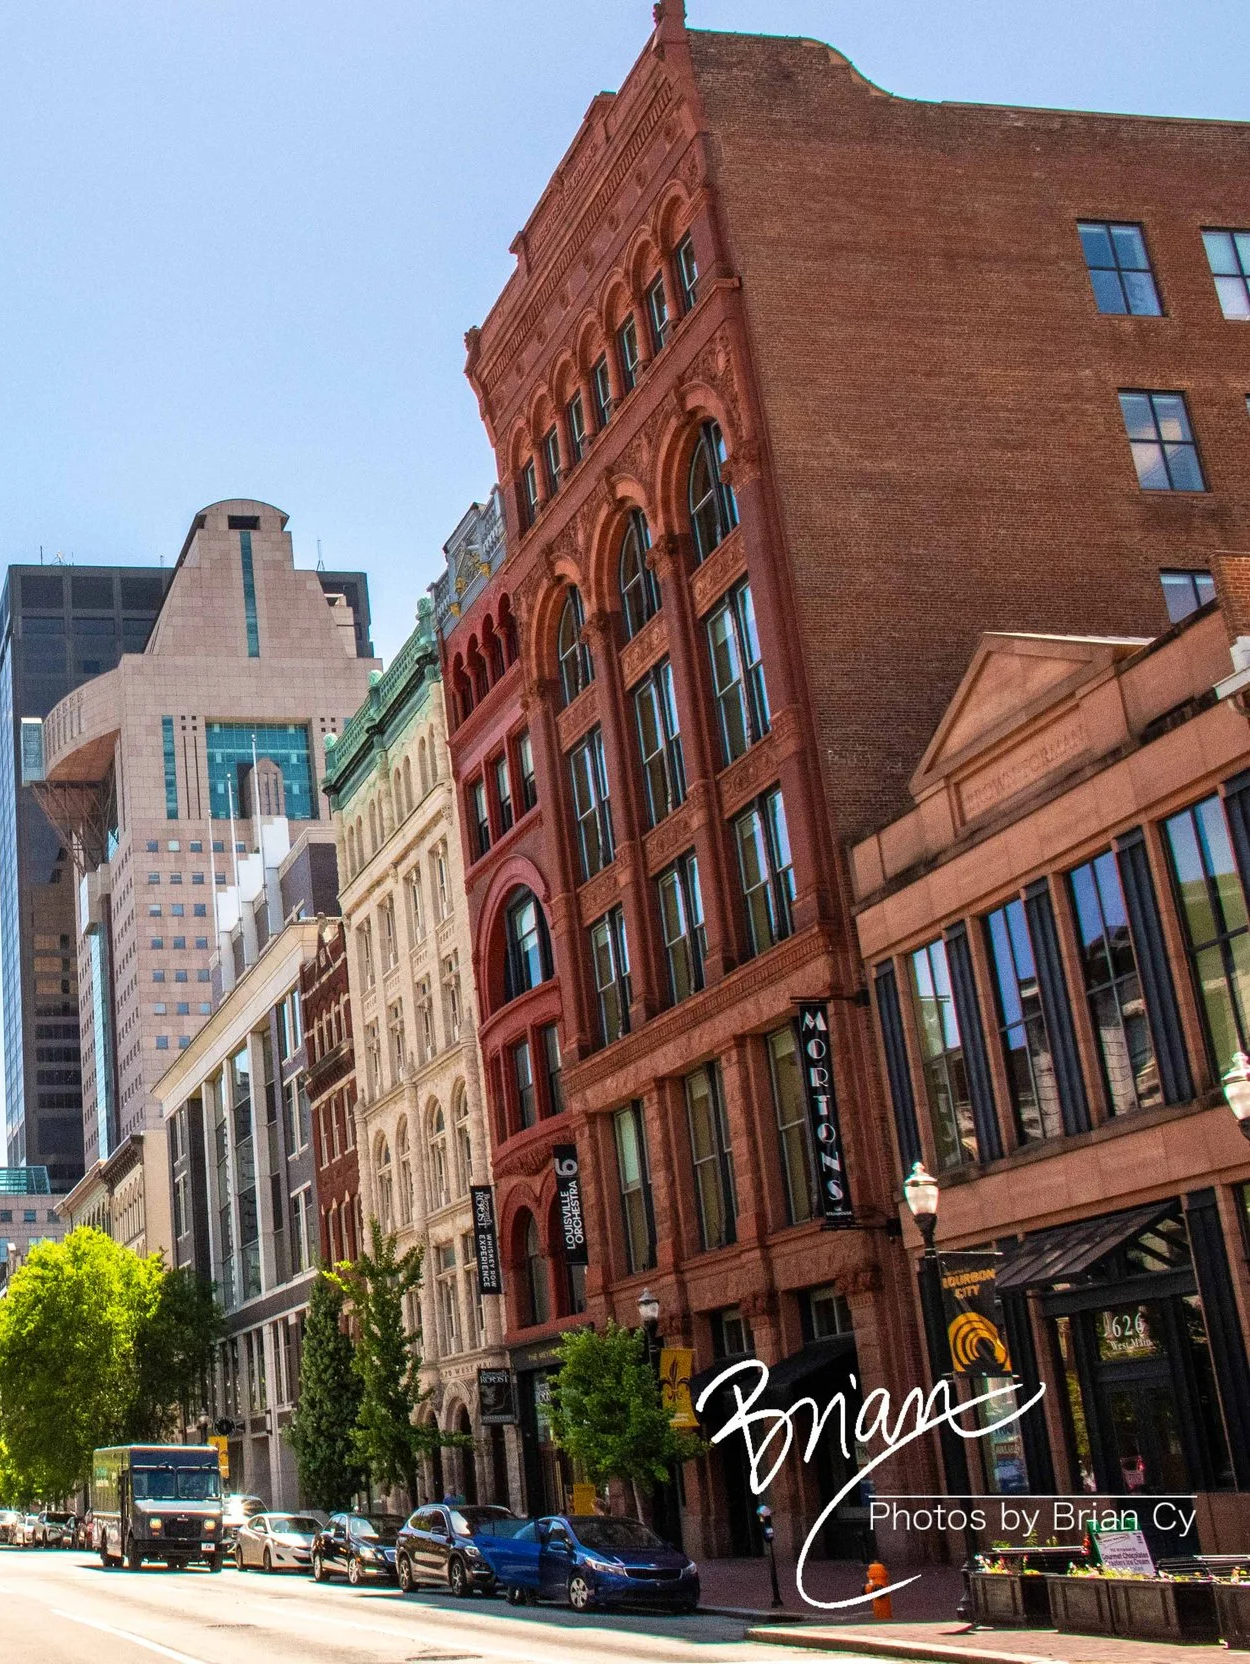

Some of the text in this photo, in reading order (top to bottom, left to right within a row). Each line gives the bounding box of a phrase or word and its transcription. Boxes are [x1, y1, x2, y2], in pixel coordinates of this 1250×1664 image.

[475, 1191, 487, 1228] ROOST
[560, 1191, 576, 1250] LOUISVILLE
[568, 1180, 584, 1244] ORCHESTRA
[478, 1234, 491, 1287] EXPERIENCE
[486, 1233, 496, 1268] WHISKEY
[954, 1284, 980, 1300] CITY
[1112, 1312, 1144, 1338] 626
[1110, 1338, 1153, 1351] West Main
